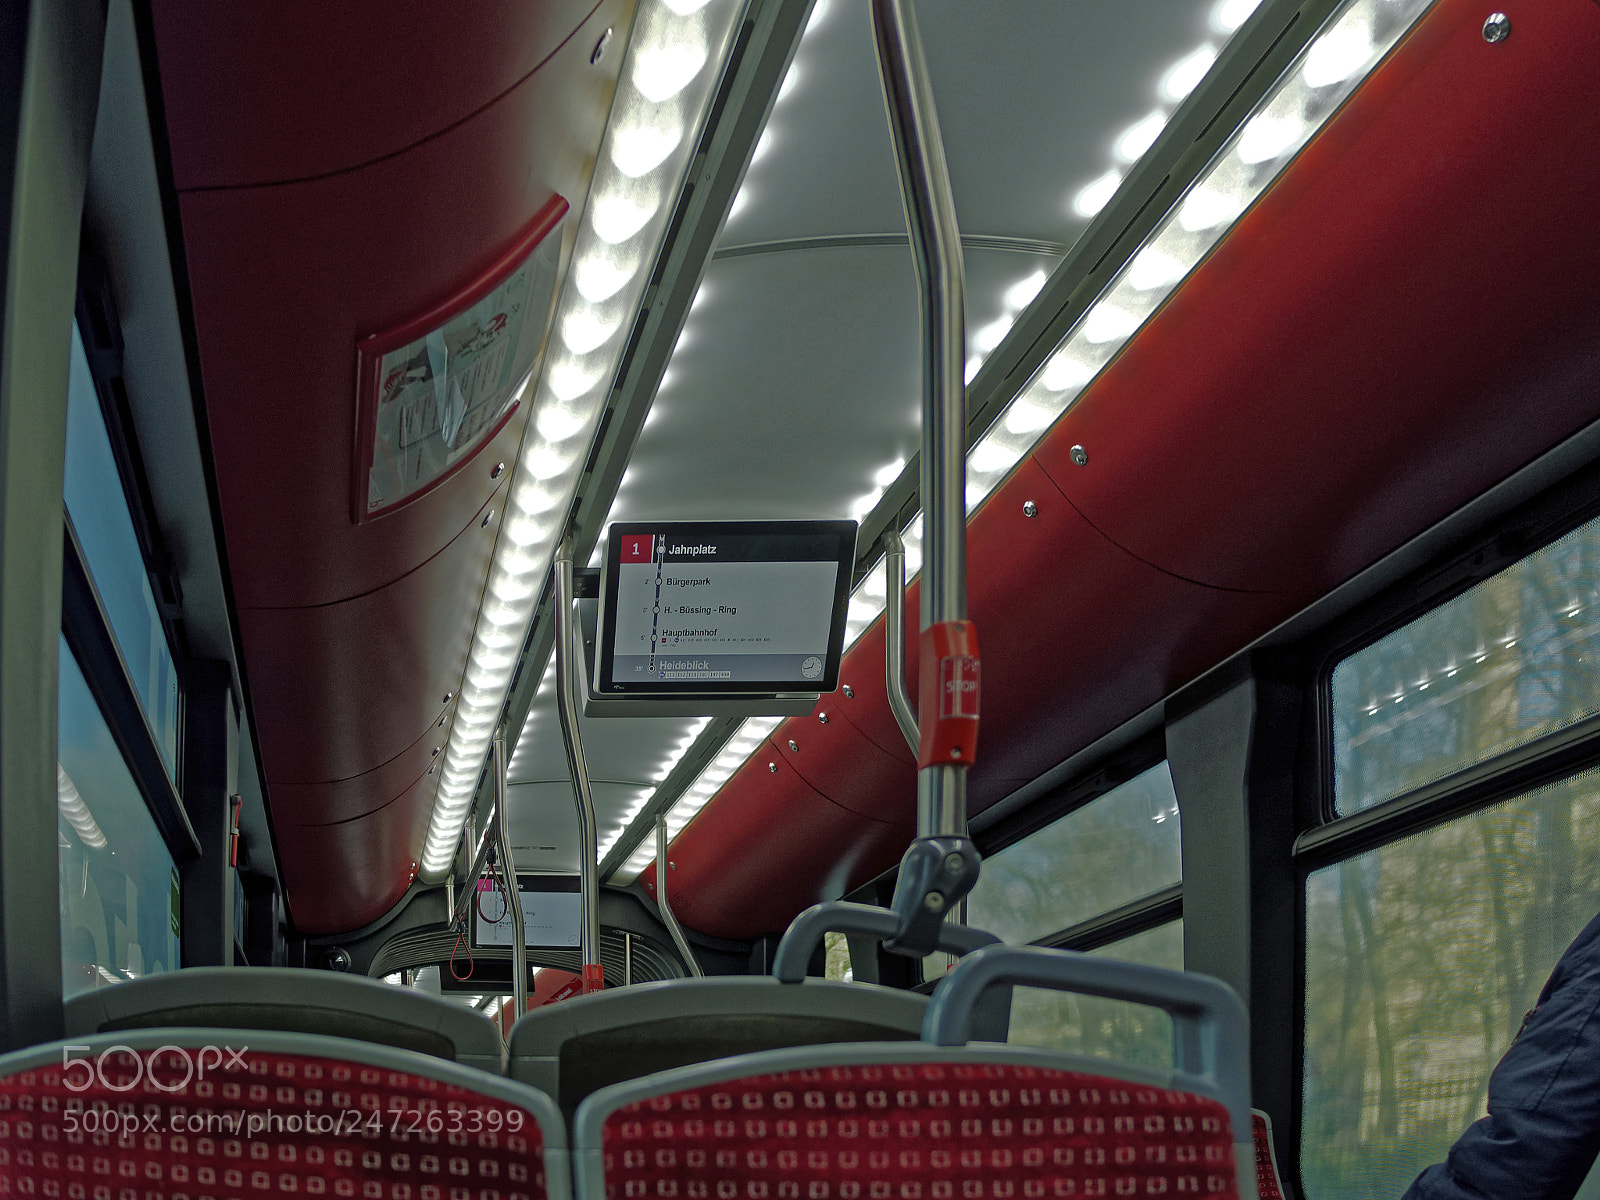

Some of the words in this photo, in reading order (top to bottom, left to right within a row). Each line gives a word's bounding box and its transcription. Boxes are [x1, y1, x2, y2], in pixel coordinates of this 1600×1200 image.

[632, 542, 640, 555] 1
[668, 544, 717, 556] Jahnplatz
[666, 578, 711, 587] Bürgerpark
[679, 606, 711, 615] Büssing
[718, 606, 737, 615] Ring
[662, 629, 718, 638] Hauptbahnhof
[659, 660, 709, 670] Heideblick
[946, 680, 976, 693] STOP
